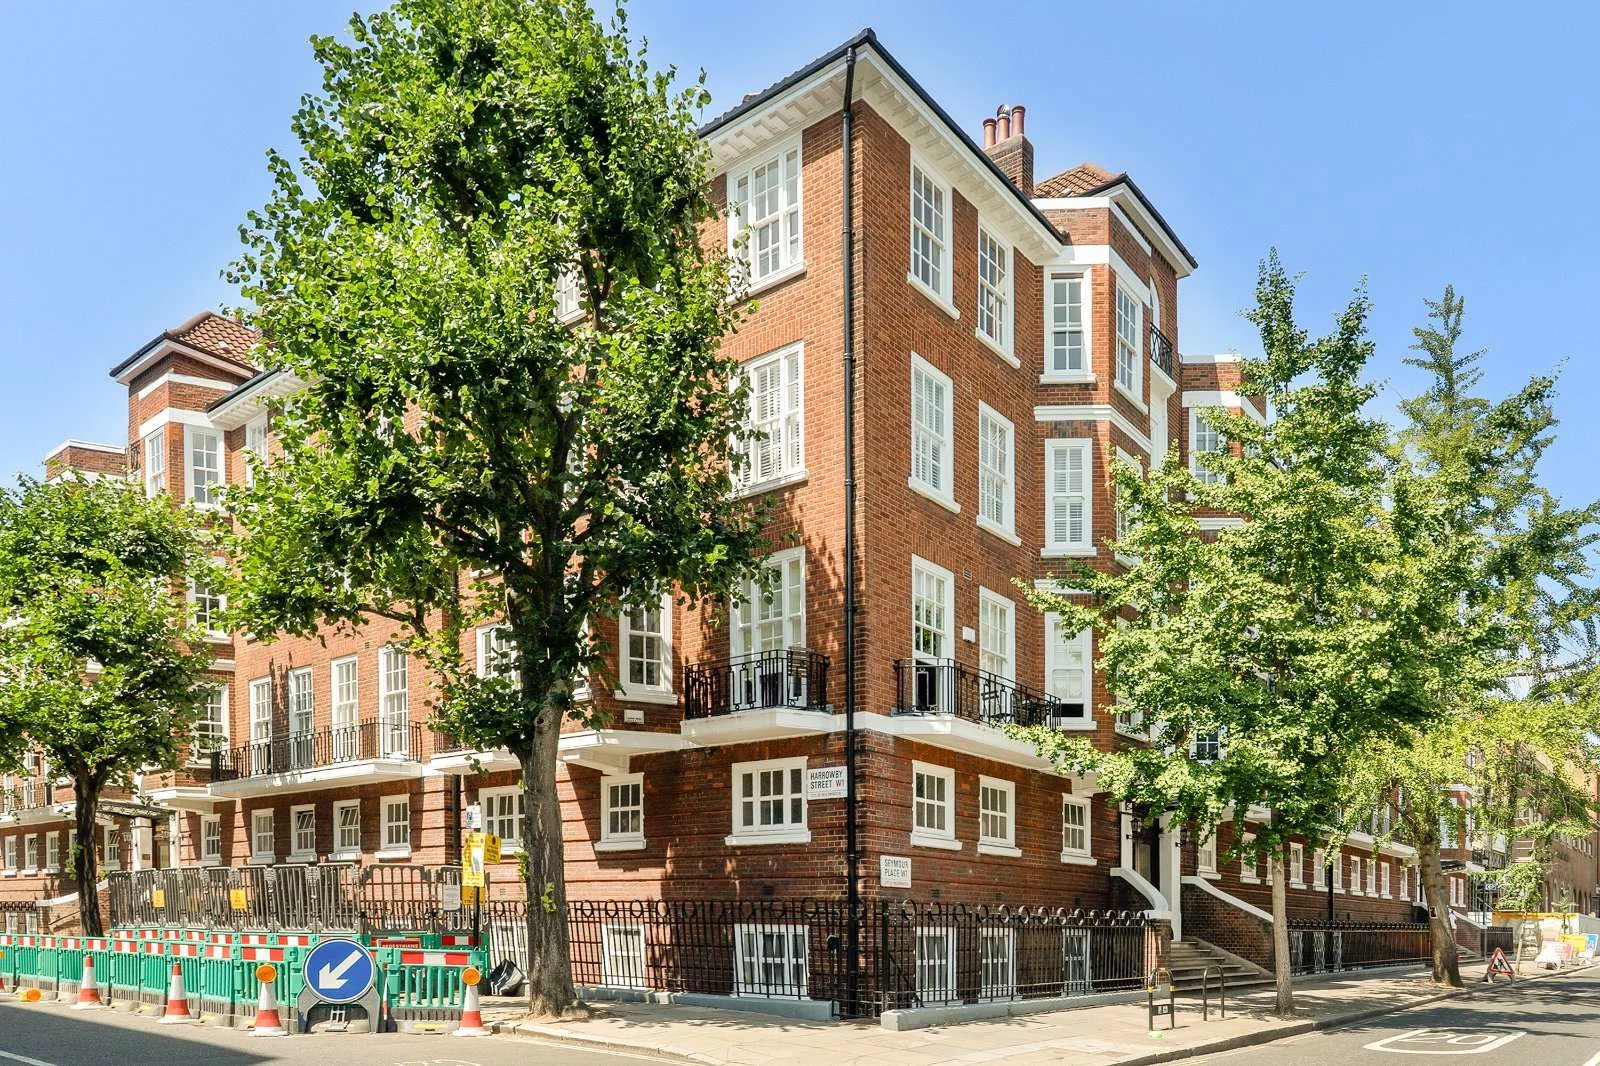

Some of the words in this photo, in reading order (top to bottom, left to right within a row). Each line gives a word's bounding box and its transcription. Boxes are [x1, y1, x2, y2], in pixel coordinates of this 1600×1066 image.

[810, 770, 843, 780] HARROWBY
[810, 779, 833, 790] STREET
[835, 779, 845, 788] W1
[884, 858, 909, 869] SEYMOUR
[884, 868, 900, 877] PLACE
[1398, 1032, 1498, 1045] 20
